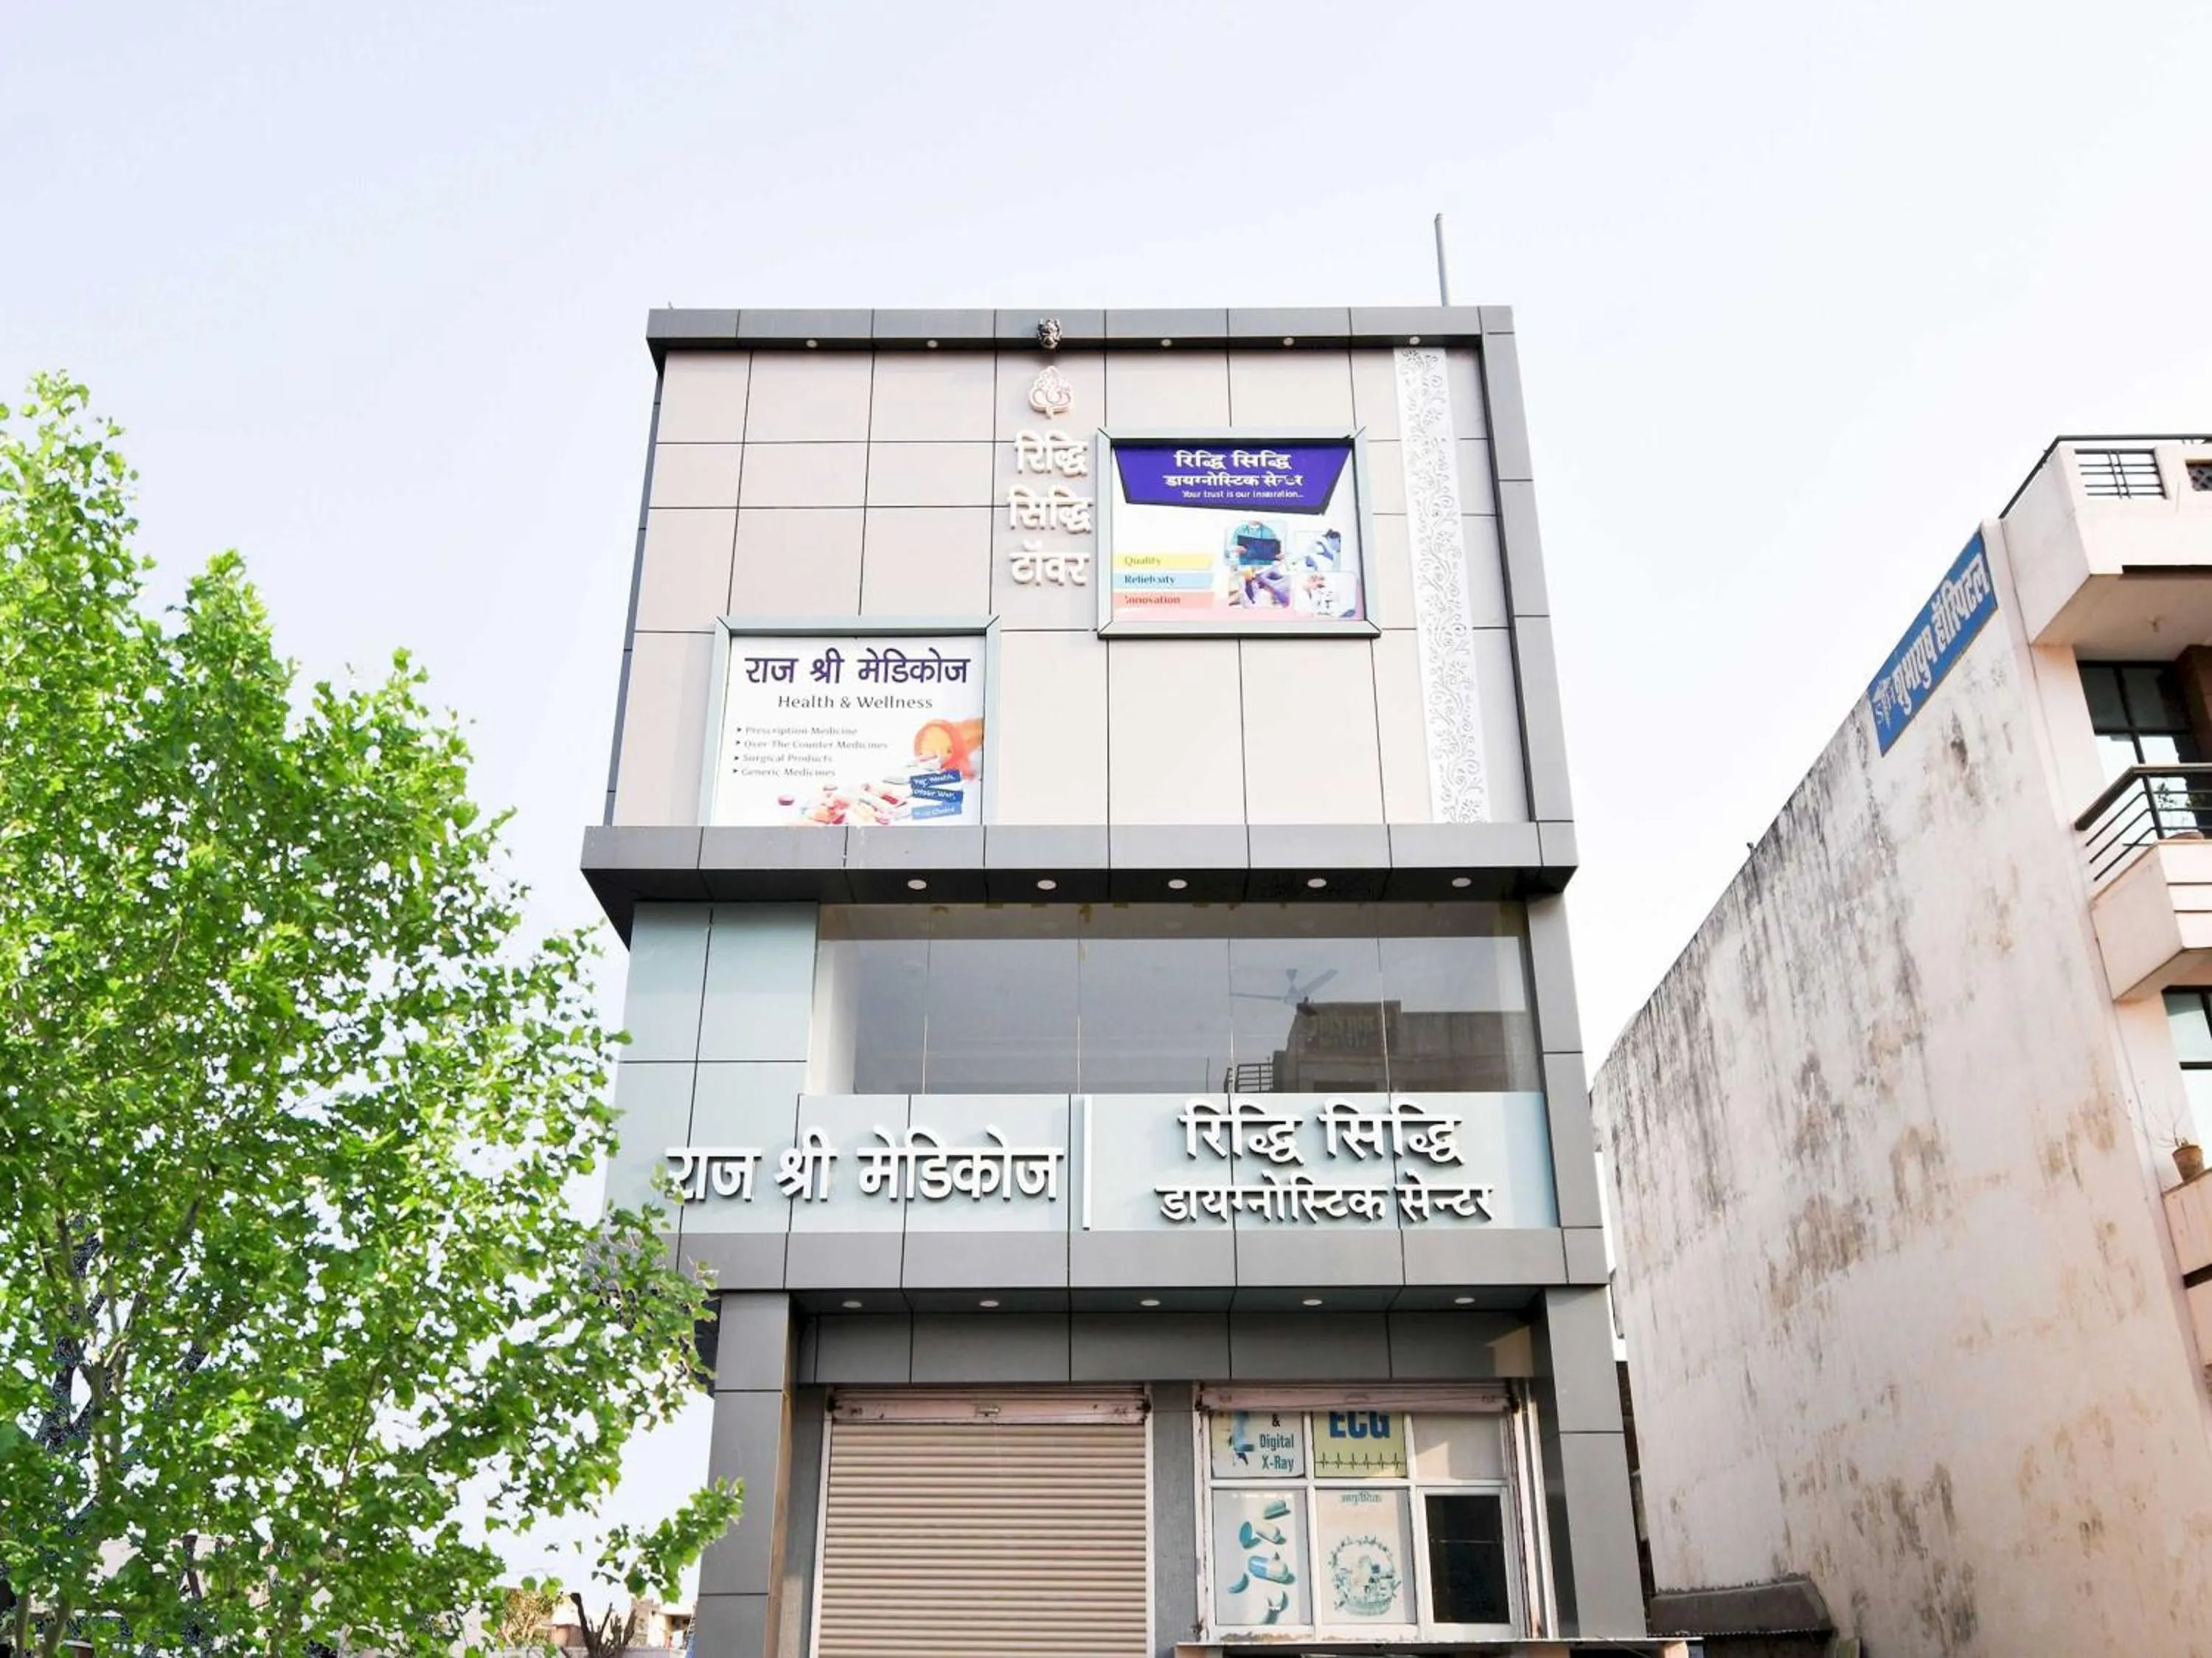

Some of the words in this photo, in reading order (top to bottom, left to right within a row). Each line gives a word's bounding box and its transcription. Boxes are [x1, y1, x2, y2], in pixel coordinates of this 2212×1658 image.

[1015, 430, 1088, 478] रिद्धि
[1173, 450, 1226, 470] रिद्धि
[1231, 450, 1292, 470] सिद्धि
[1203, 490, 1224, 498] trust
[1226, 490, 1234, 498] is
[1008, 484, 1093, 535] सिद्धि
[1009, 539, 1090, 586] टॉवर
[1124, 555, 1161, 566] Quality
[745, 657, 799, 684] राज
[810, 648, 845, 684] श्री
[857, 648, 971, 684] मेडिकोज
[778, 696, 835, 709] Health
[840, 696, 851, 709] &
[856, 696, 933, 709] Wellness
[744, 740, 767, 748] Over
[772, 740, 790, 748] The
[793, 740, 833, 749] Counter
[742, 755, 785, 763] Surgical
[741, 769, 779, 777] Generic
[1178, 1099, 1304, 1165] रिद्धि
[1317, 1097, 1464, 1165] सिद्धि
[666, 1146, 762, 1202] राज
[774, 1125, 838, 1203] श्री
[856, 1123, 1064, 1203] मेडिकोज
[1155, 1169, 1390, 1224] डायग्नोस्टिक
[1394, 1168, 1494, 1223] सेन्टर
[1272, 1414, 1281, 1427] &
[1329, 1412, 1391, 1439] ECG
[1259, 1434, 1295, 1451] Digital
[1262, 1456, 1294, 1472] X-Ray
